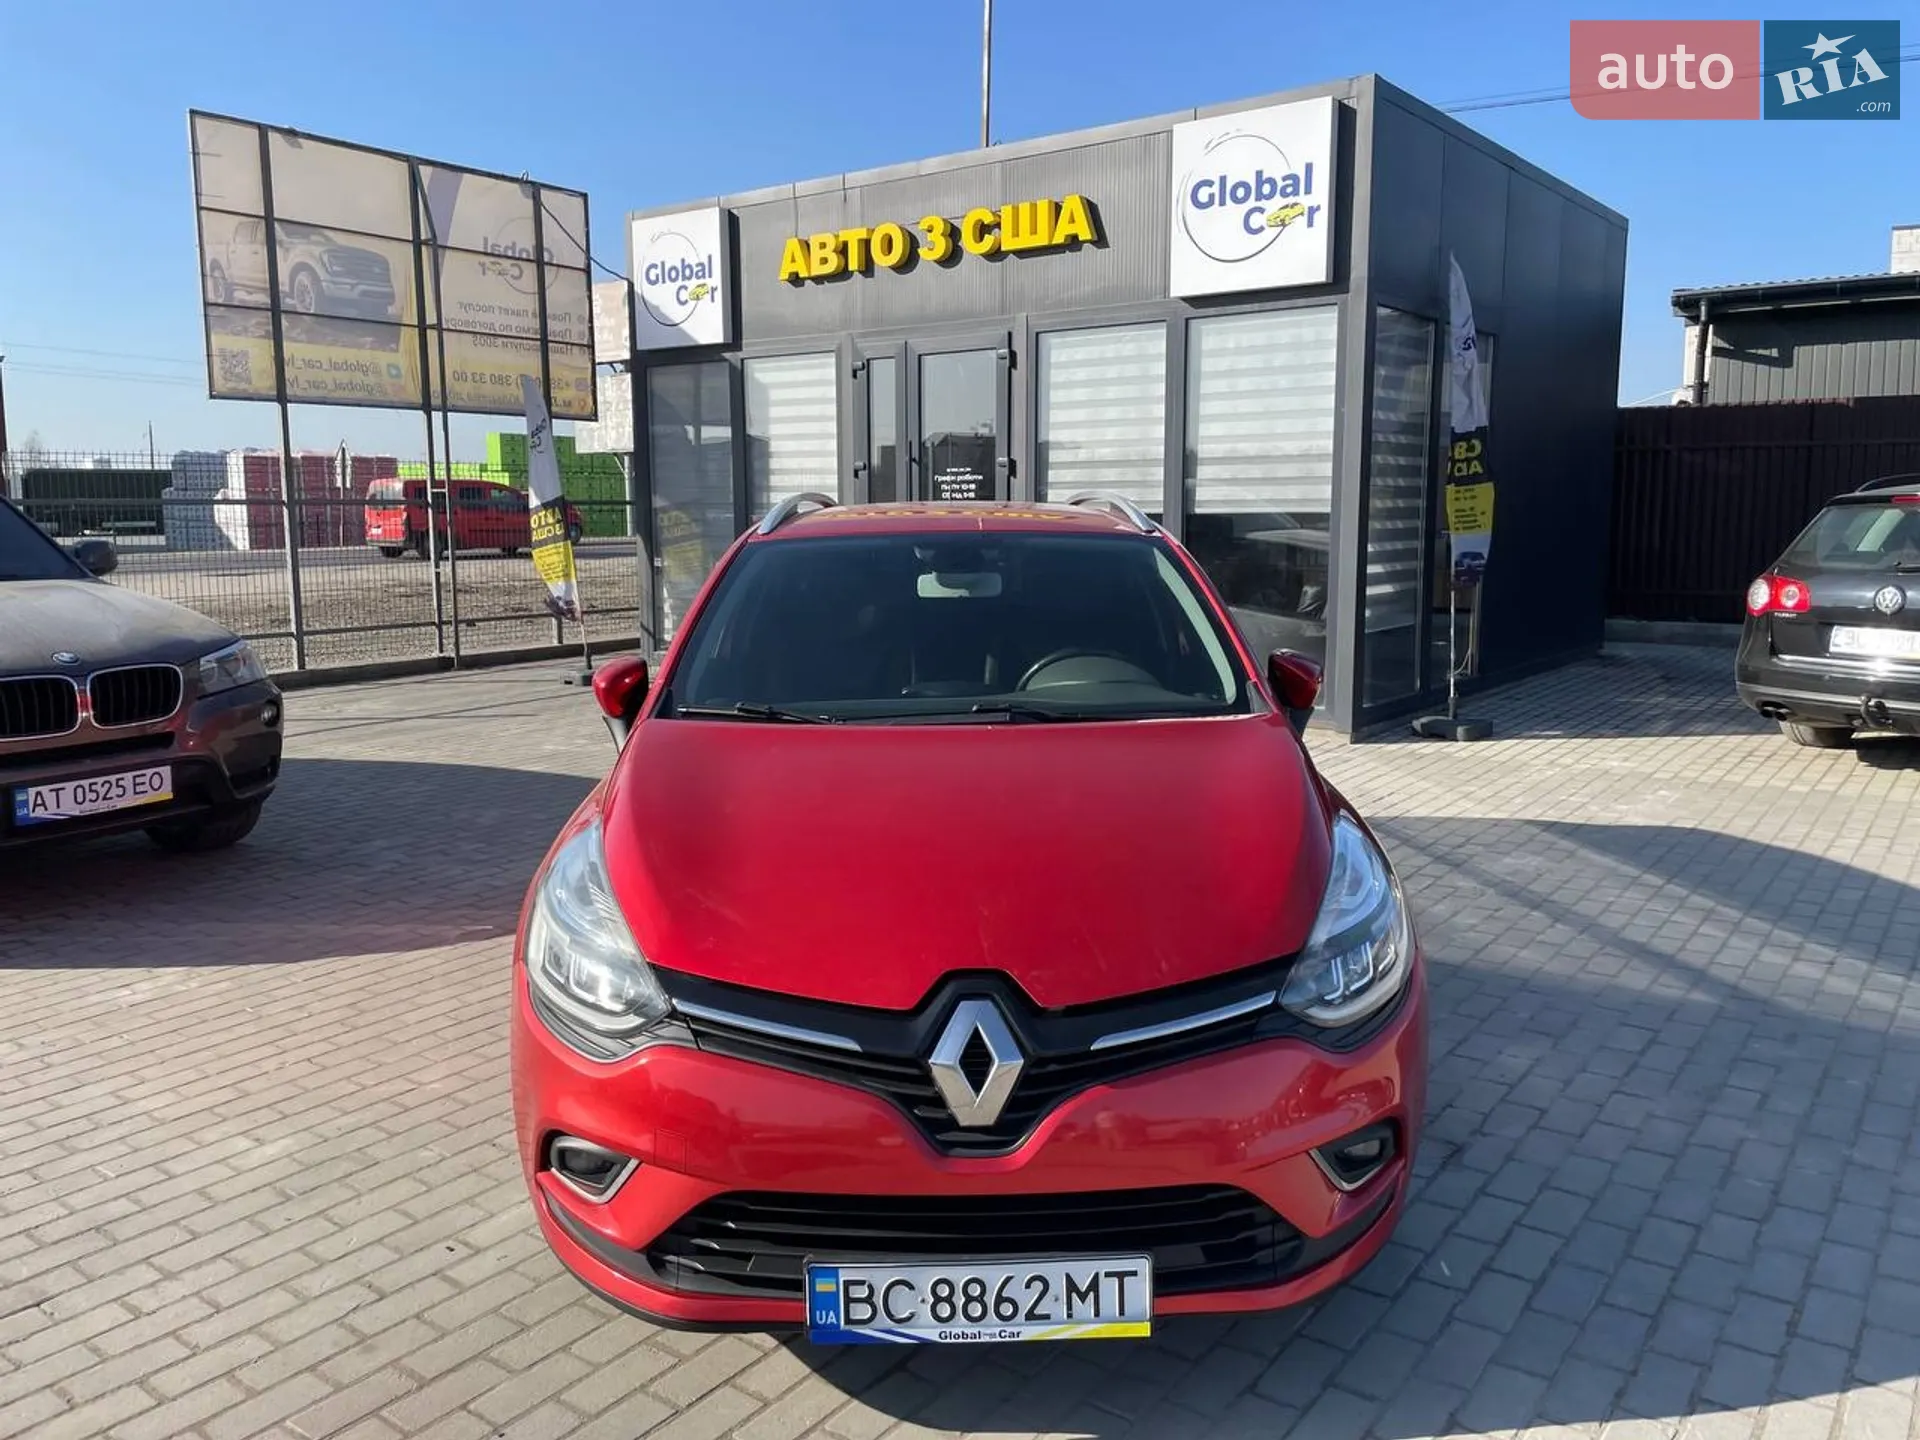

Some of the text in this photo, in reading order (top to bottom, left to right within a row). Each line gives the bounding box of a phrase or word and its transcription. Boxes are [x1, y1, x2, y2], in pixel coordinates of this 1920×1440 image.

[1190, 162, 1313, 210] Global
[779, 222, 909, 285] АВТО
[961, 194, 1096, 255] США
[645, 254, 712, 286] Global
[32, 786, 66, 813] AT
[73, 777, 126, 806] 0525
[133, 771, 164, 796] EO
[816, 1310, 837, 1325] UA
[842, 1270, 1138, 1326] BC 8862 MT
[938, 1330, 981, 1341] Global
[998, 1328, 1022, 1339] Car
